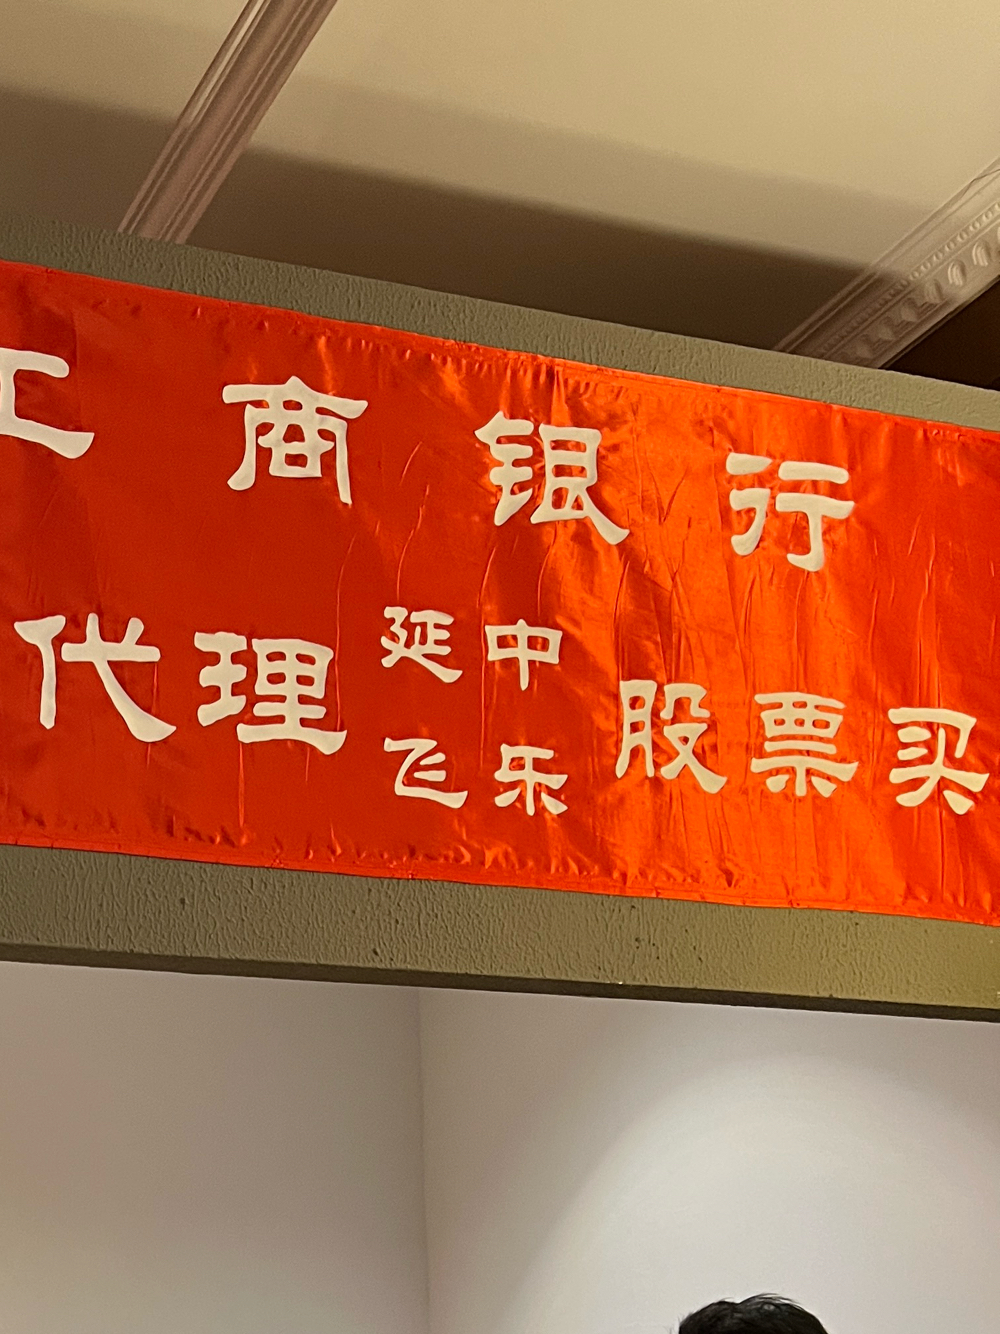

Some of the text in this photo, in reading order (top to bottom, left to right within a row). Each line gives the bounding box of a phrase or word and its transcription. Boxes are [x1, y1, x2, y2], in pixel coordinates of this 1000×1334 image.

[13, 612, 347, 756] 代理
[380, 606, 563, 691] 延中
[383, 736, 568, 816] 飞乐
[615, 679, 990, 815] 股票买
